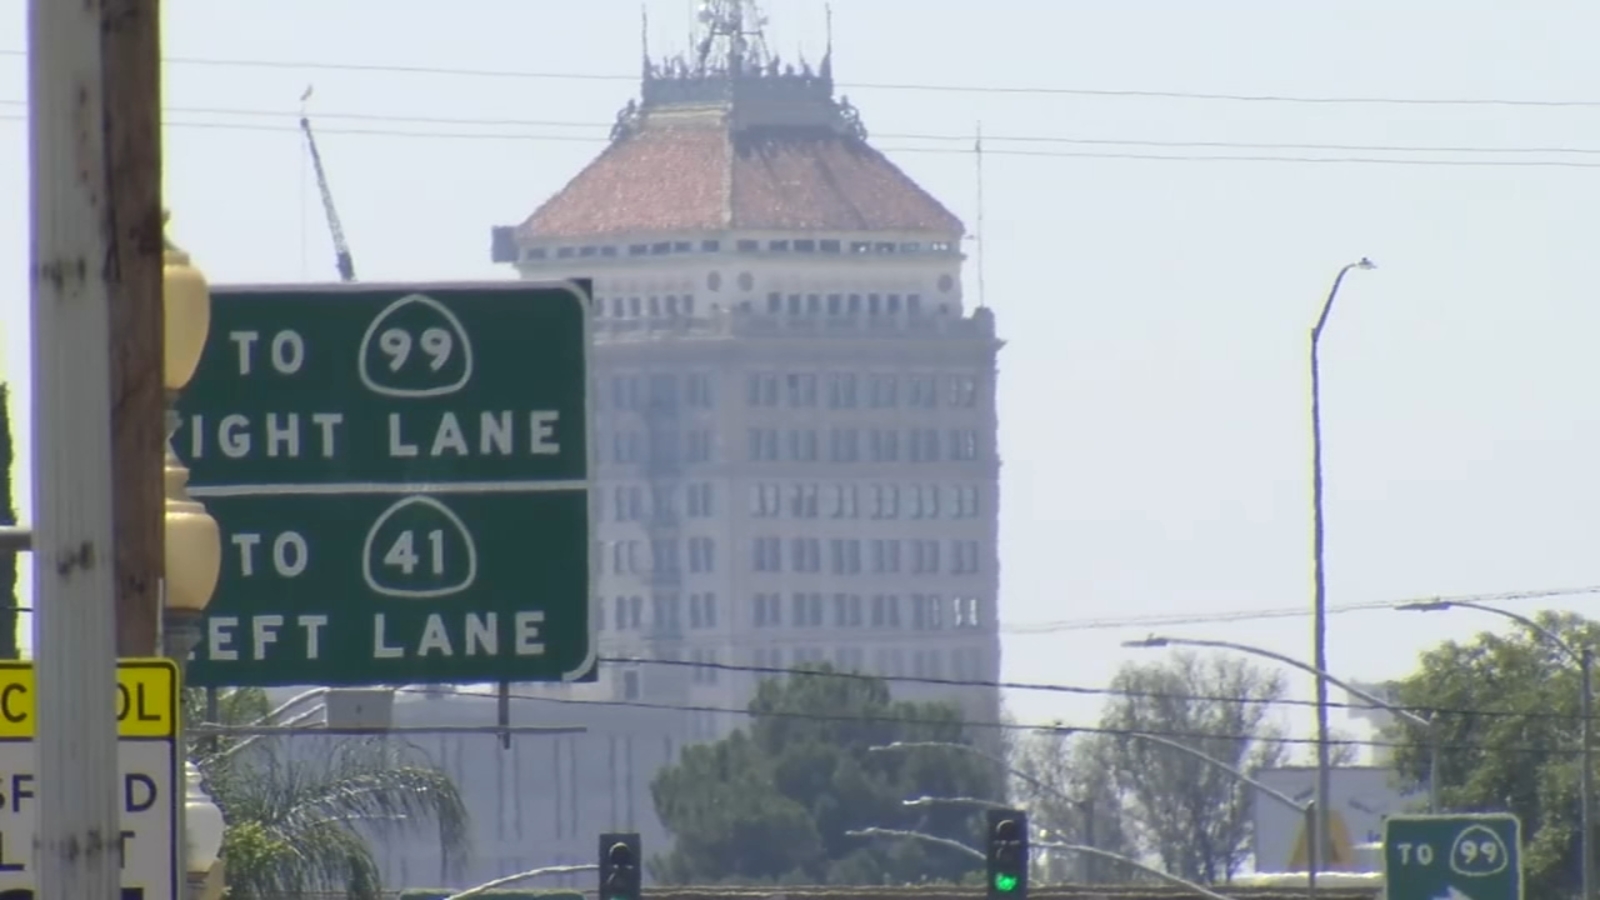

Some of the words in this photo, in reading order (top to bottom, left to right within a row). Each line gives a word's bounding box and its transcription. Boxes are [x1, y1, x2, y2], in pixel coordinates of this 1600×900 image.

[230, 329, 304, 375] TO
[379, 328, 453, 372] 99
[389, 410, 561, 457] LANE
[232, 530, 308, 577] TO
[383, 529, 444, 575] 41
[187, 614, 328, 661] EFT
[373, 611, 546, 659] LANE
[1397, 843, 1434, 866] TO
[1459, 840, 1497, 865] 99
